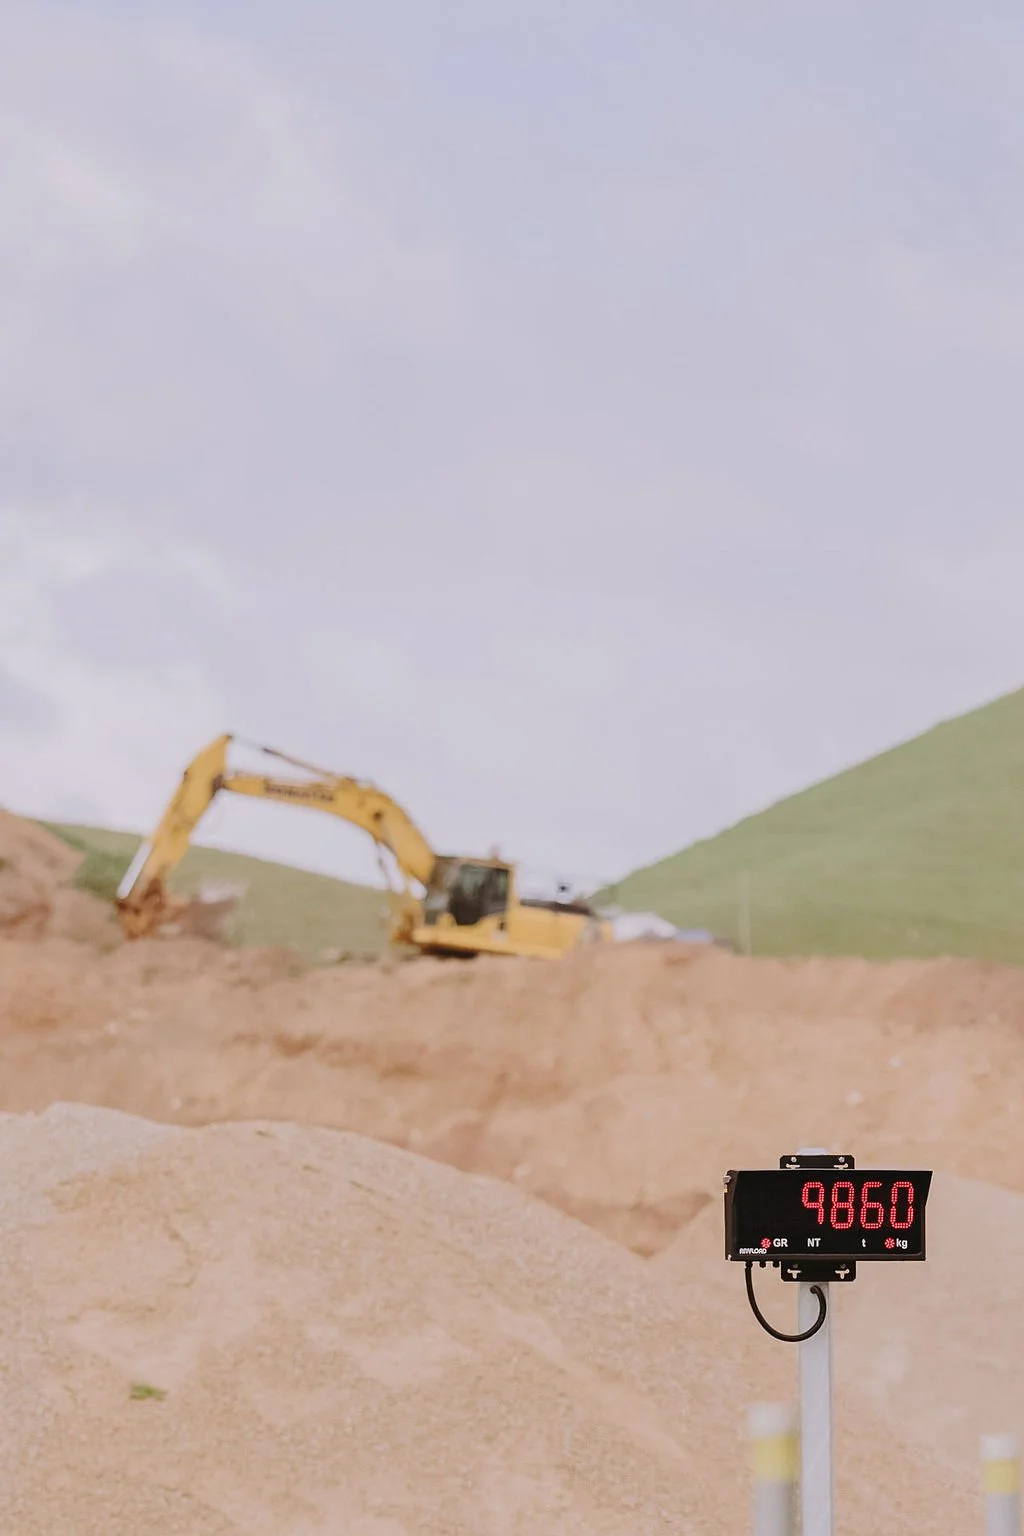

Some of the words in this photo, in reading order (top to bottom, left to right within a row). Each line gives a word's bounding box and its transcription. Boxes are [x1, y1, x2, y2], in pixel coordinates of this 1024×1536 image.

[801, 1181, 914, 1229] 9860
[773, 1238, 788, 1248] GR
[807, 1238, 821, 1248] NT
[862, 1238, 867, 1247] t
[895, 1238, 908, 1250] kg
